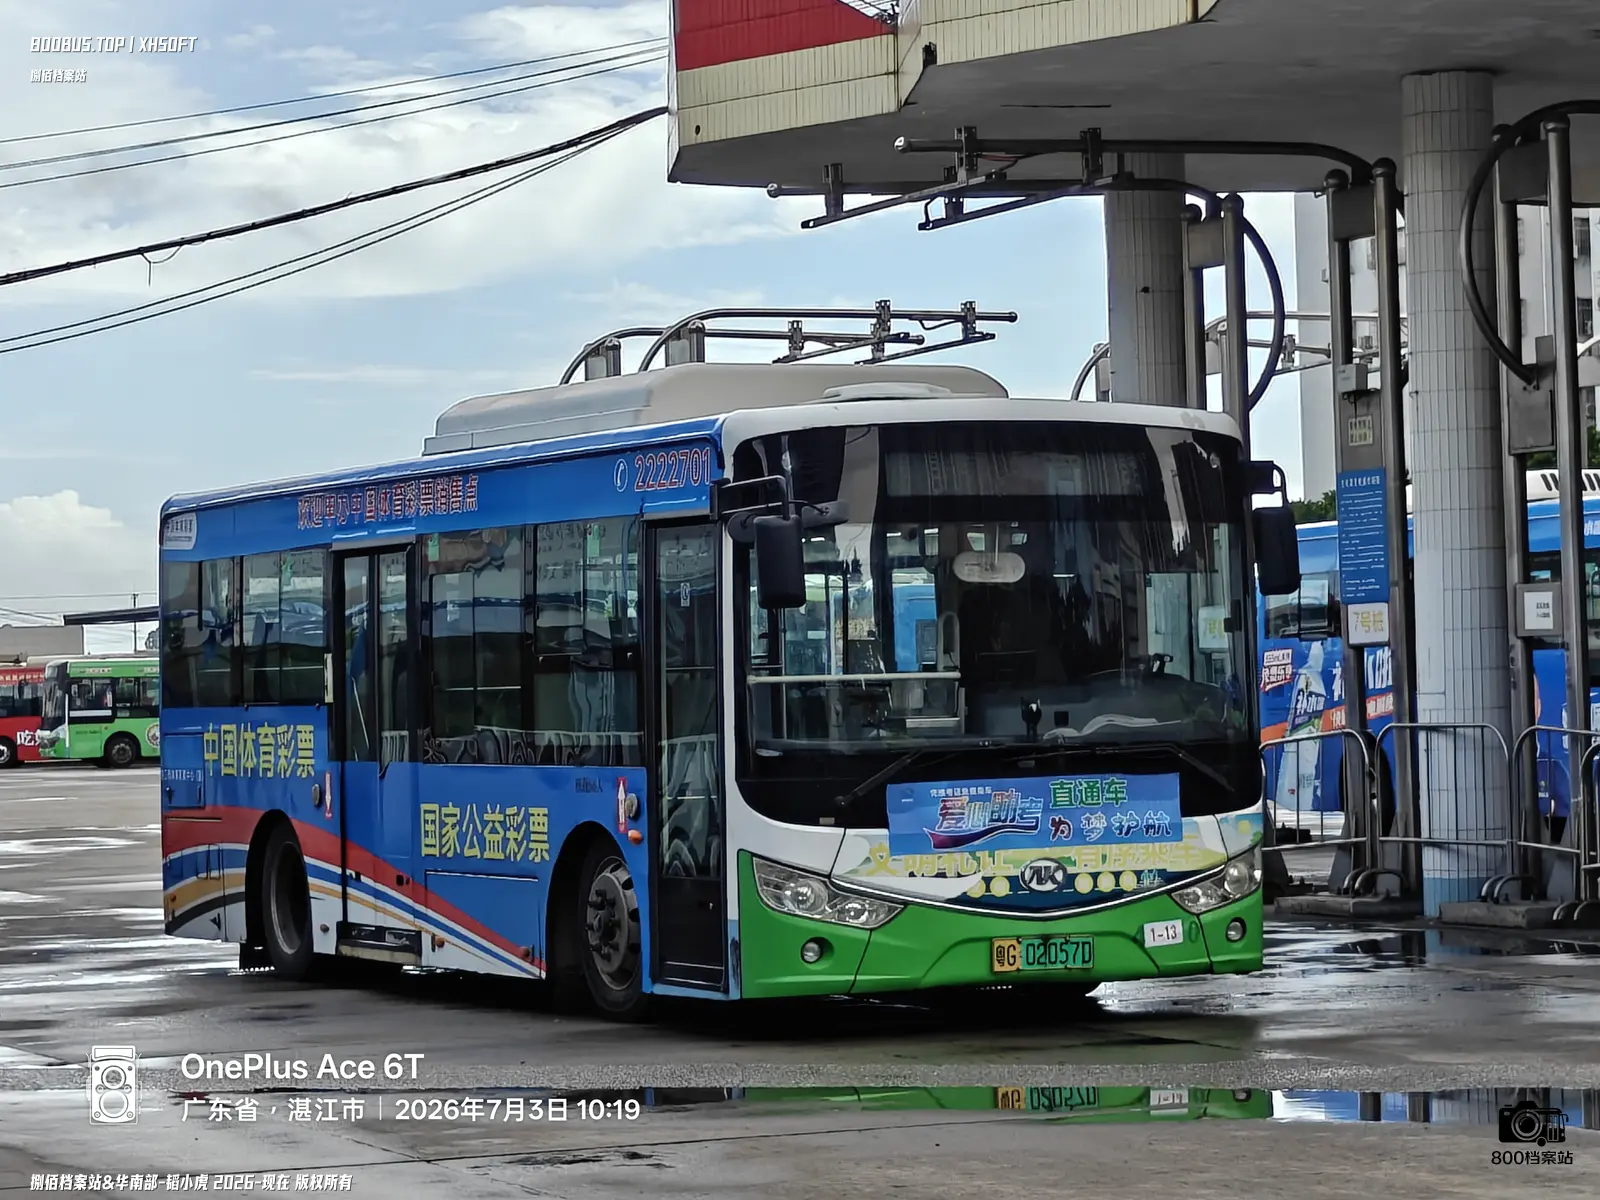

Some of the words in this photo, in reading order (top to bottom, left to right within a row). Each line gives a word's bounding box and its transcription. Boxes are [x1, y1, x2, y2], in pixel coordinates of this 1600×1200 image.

[634, 448, 711, 492] 2222701
[298, 474, 479, 530] 欢迎申办中国体育彩票销售点
[203, 721, 315, 779] 中国体育彩票
[1049, 777, 1128, 809] 直通车
[420, 802, 550, 862] 国家公益彩票
[1049, 810, 1172, 842] 为梦护航
[1150, 925, 1178, 942] 1-13
[1026, 941, 1093, 966] 02057D
